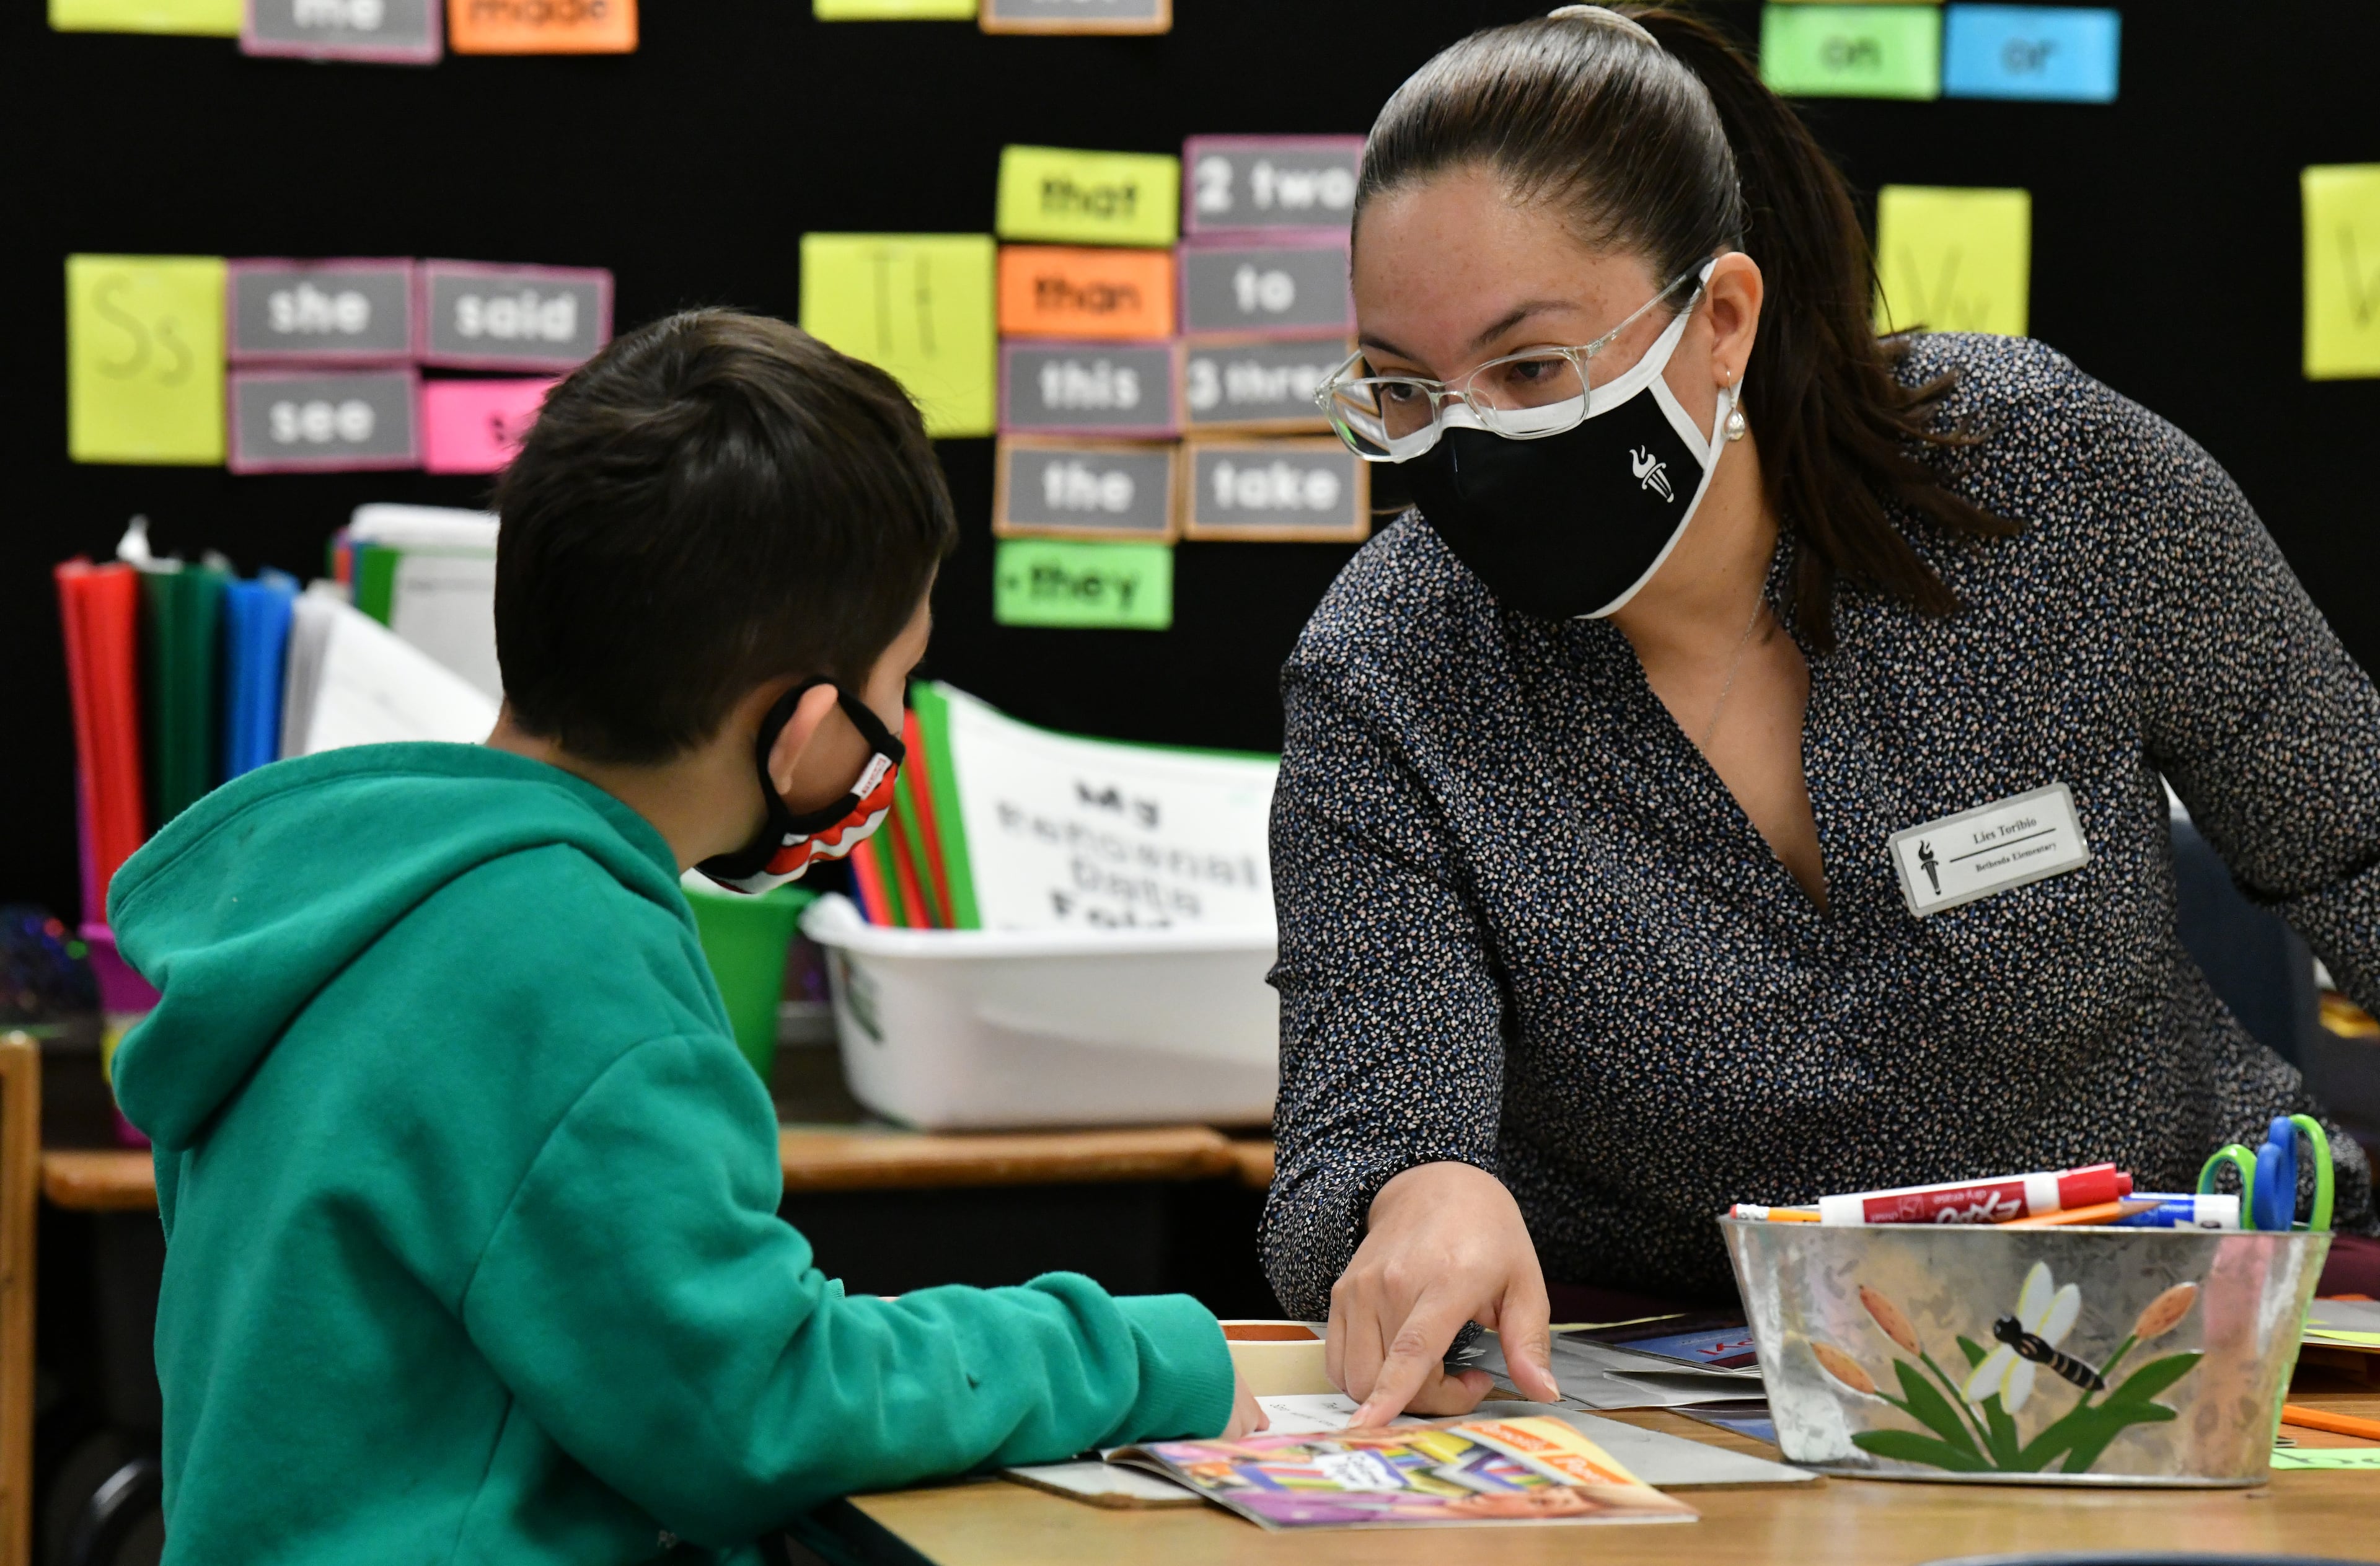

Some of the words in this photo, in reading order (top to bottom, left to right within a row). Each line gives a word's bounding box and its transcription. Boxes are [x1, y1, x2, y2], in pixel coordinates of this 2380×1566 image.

[1820, 33, 1882, 75] on
[1999, 35, 2061, 75] or
[1041, 174, 1137, 218] that
[1196, 155, 1233, 213] 2
[1251, 159, 1355, 210] two
[268, 281, 370, 335] she
[1034, 271, 1142, 311] than
[1232, 262, 1296, 313] to
[89, 270, 195, 389] Ss
[454, 289, 578, 342] said
[1039, 358, 1141, 410] this
[1187, 357, 1221, 411] 3
[269, 398, 376, 444] see
[1043, 459, 1135, 514] the
[1212, 459, 1341, 512] take
[1029, 563, 1138, 614] they
[1973, 830, 1996, 845] Lies
[1998, 817, 2037, 835] Toribio
[2012, 841, 2058, 861] Elementary
